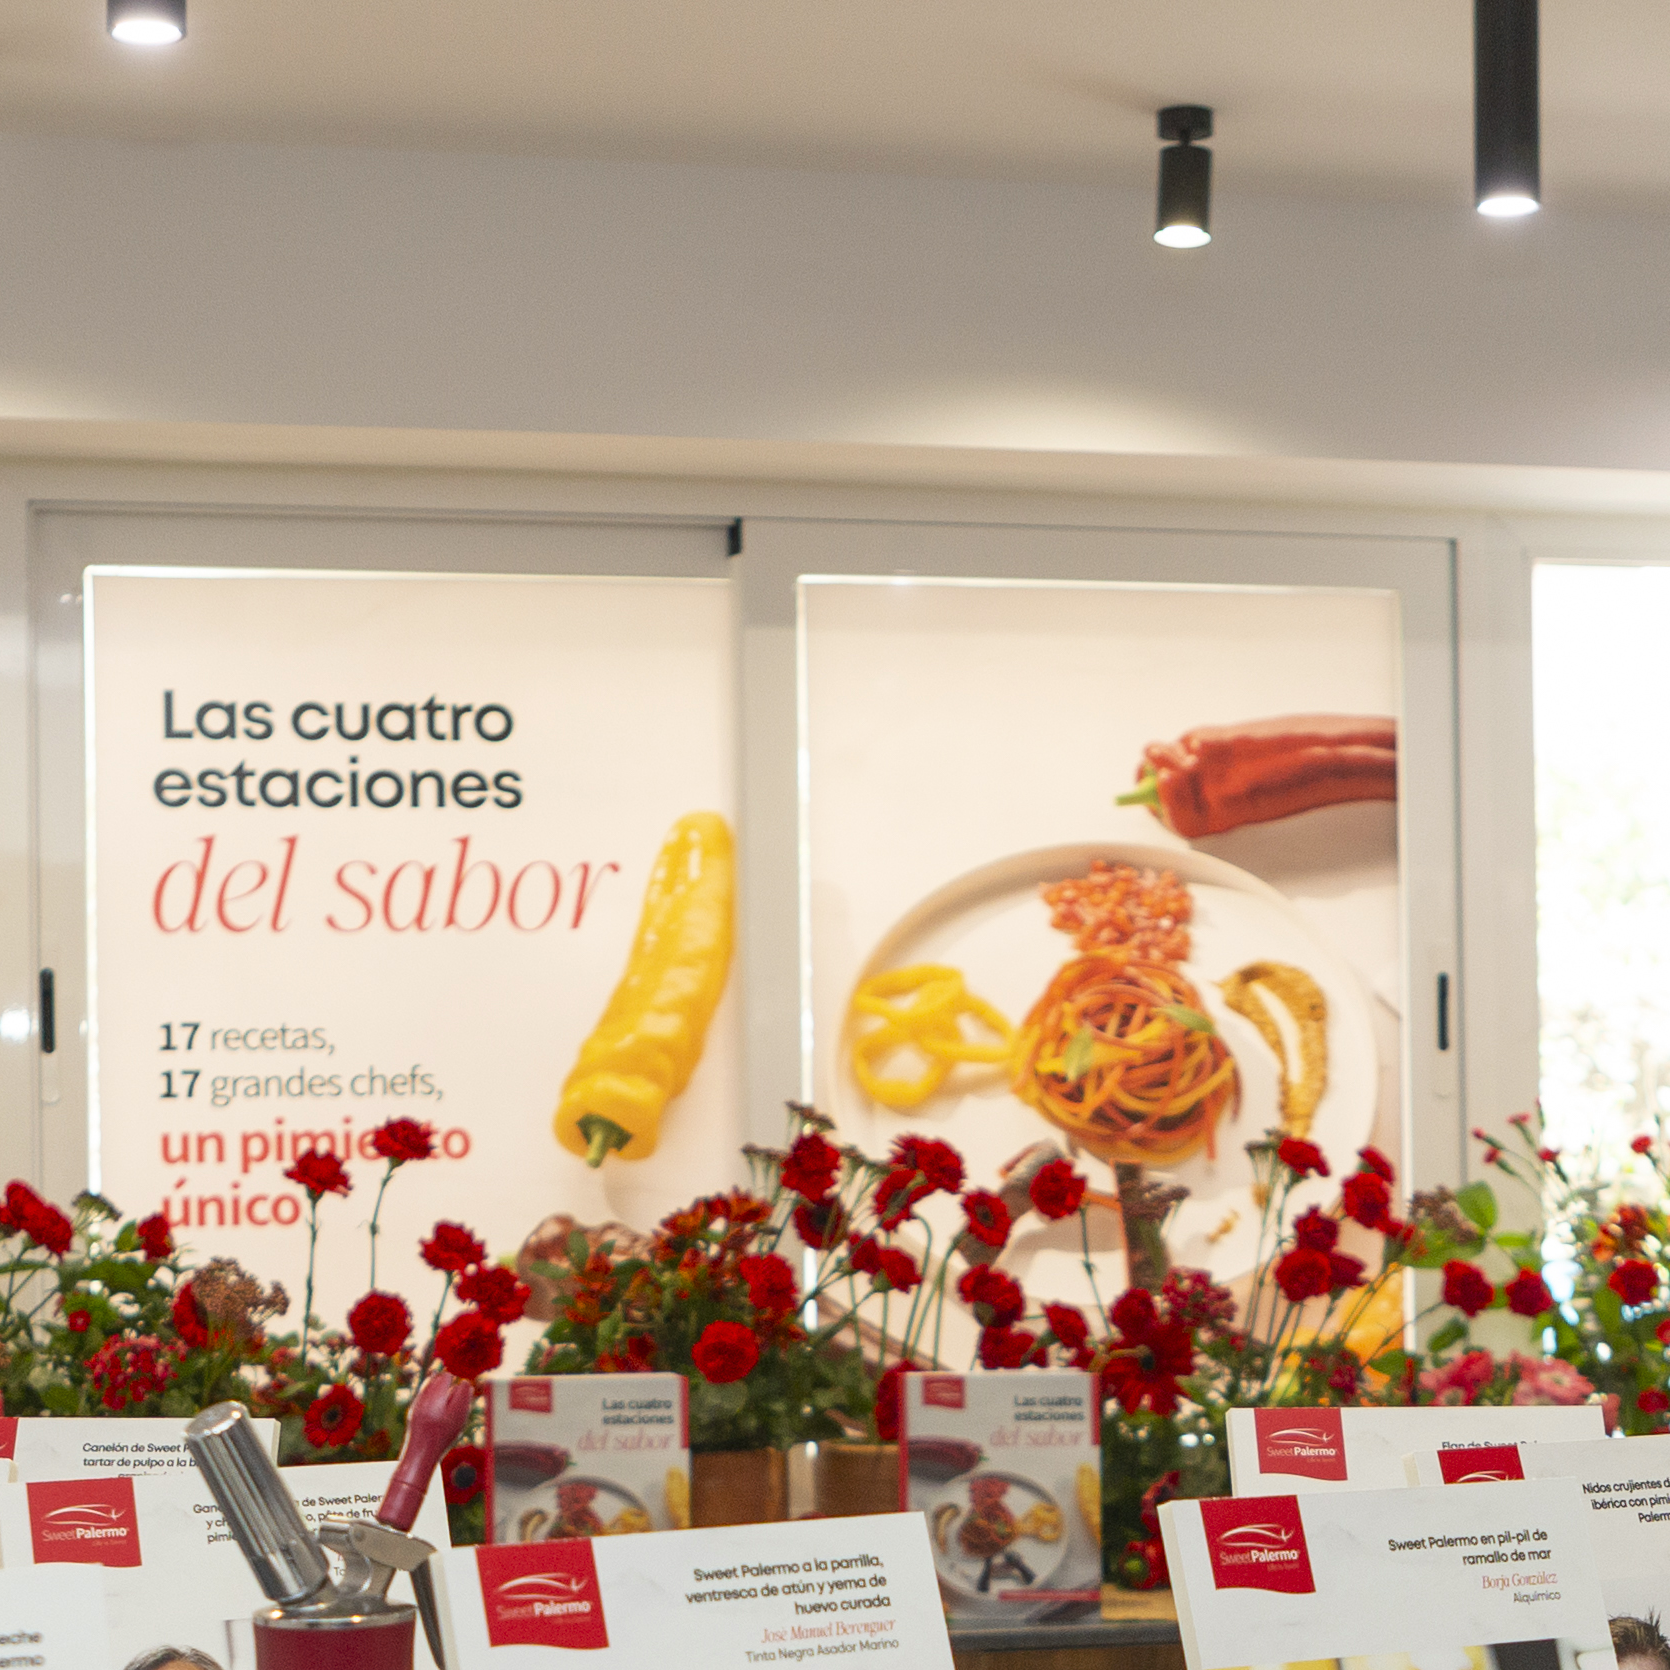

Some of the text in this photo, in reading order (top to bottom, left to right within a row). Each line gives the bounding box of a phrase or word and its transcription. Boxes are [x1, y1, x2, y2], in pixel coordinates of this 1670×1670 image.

[161, 691, 514, 742] Las cuatro
[153, 756, 524, 809] estaciones
[152, 834, 621, 933] del sabor
[159, 1022, 336, 1055] 17 recetas,
[159, 1065, 444, 1106] 17 grandes chefs,
[161, 1116, 472, 1174] un pimieo
[161, 1177, 301, 1228] único
[82, 1442, 181, 1453] Canelón de Sweet
[83, 1457, 186, 1468] tartar de pulpo a la
[1582, 1482, 1612, 1495] Nidos
[1613, 1479, 1662, 1493] crujientes
[1590, 1498, 1627, 1511] ibérica
[1628, 1498, 1648, 1508] con
[1388, 1528, 1548, 1551] Sweet Palermo en pil-pil de
[693, 1554, 884, 1582] Sweet Palermo a la parrilla,
[1462, 1548, 1552, 1565] ramallo de mar
[685, 1573, 887, 1604] ventresca de atún y yema de
[1482, 1571, 1558, 1590] Borja González
[794, 1594, 891, 1615] huevo curada
[761, 1619, 896, 1643] José Manuel Berenguer
[745, 1637, 899, 1663] Tinta Negra Asador Marino
